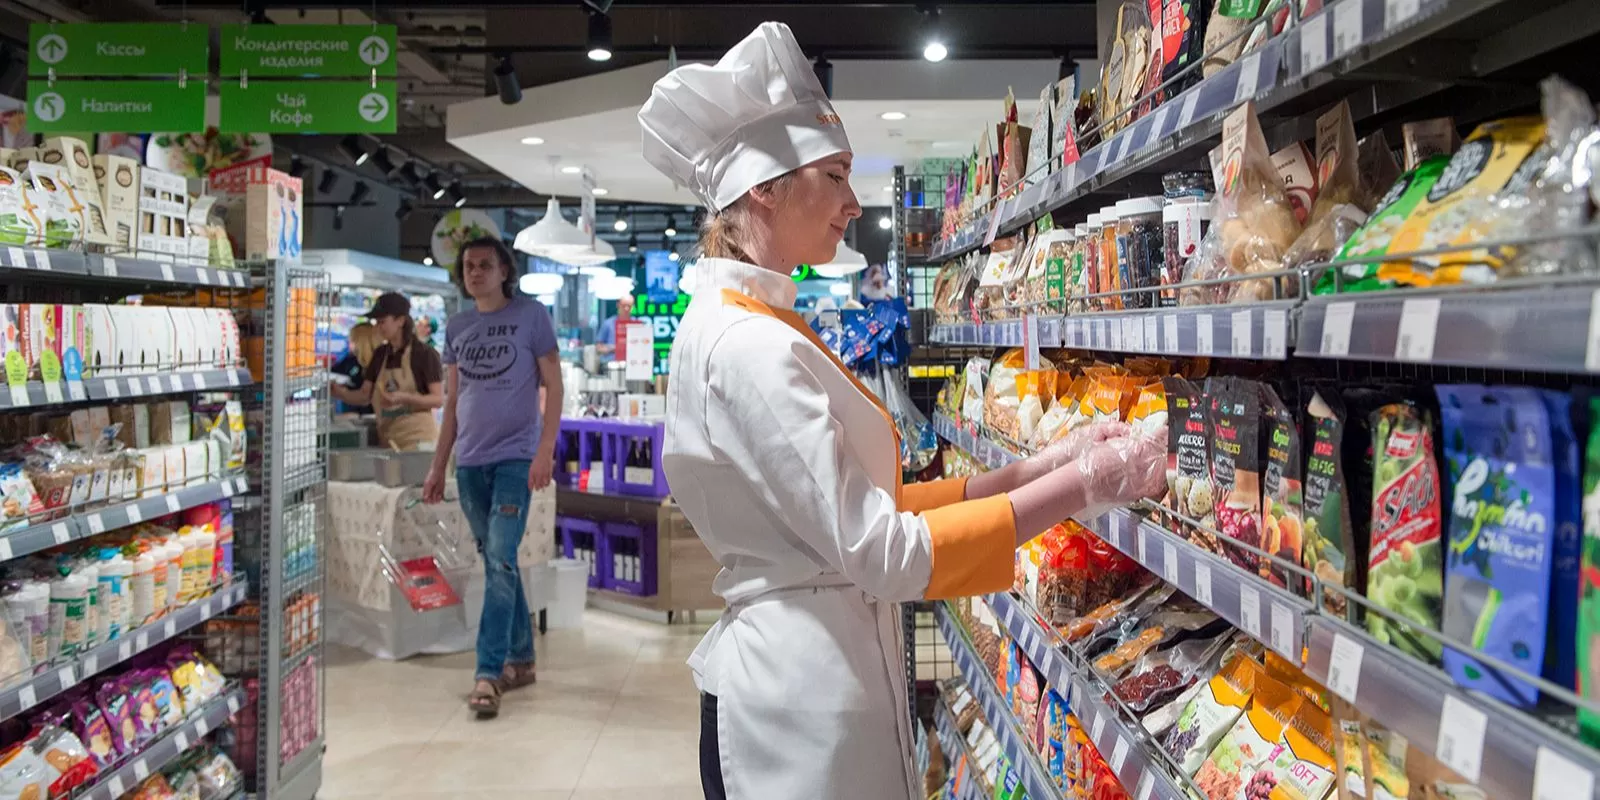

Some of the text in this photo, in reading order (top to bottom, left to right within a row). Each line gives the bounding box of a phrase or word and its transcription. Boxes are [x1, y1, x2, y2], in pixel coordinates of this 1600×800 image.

[96, 41, 146, 56] Кассы
[235, 36, 350, 54] Кондитерские
[260, 56, 324, 68] изделия
[81, 97, 153, 113] Напитки
[276, 93, 307, 108] Чай
[270, 108, 313, 127] Кофе
[487, 324, 519, 337] DRY
[455, 331, 509, 369] Super
[1290, 762, 1320, 787] SOFT
